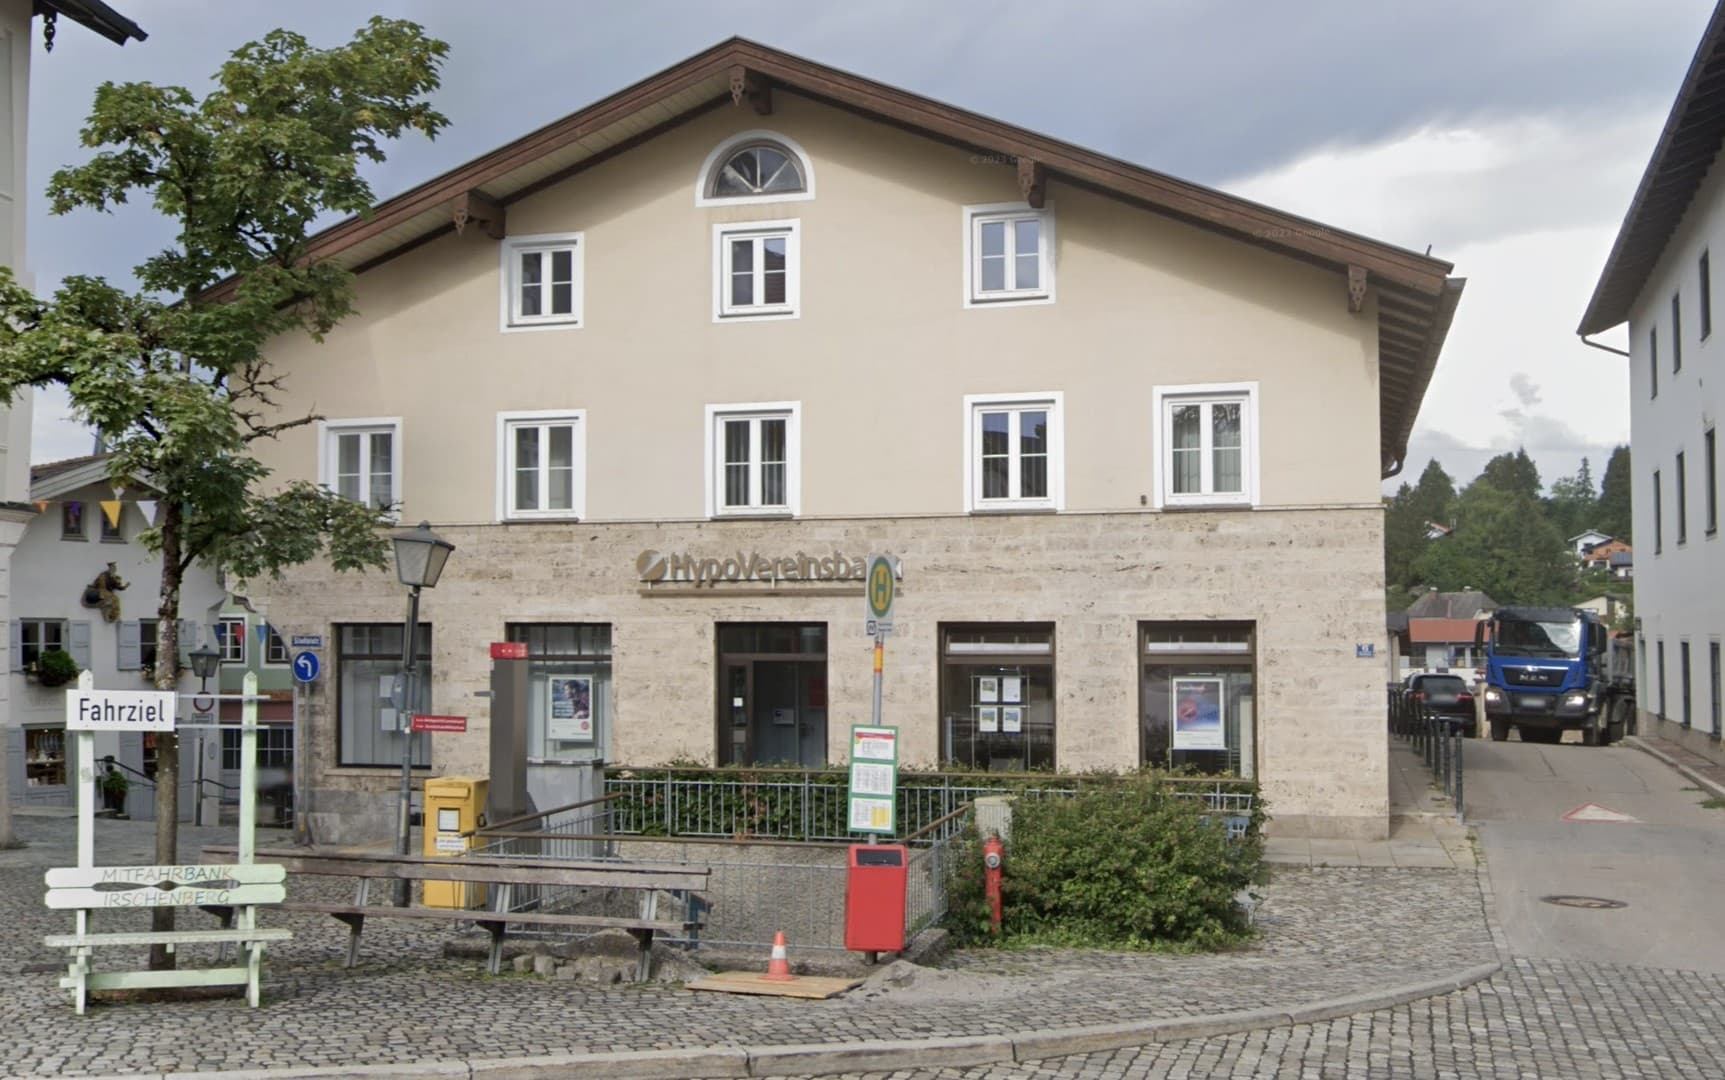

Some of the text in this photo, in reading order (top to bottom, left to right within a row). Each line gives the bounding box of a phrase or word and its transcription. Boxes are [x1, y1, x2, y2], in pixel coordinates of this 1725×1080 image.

[670, 551, 902, 588] HypoVereinsba
[79, 698, 165, 722] Fahrziel
[102, 867, 233, 882] MITFAHRBANK
[104, 890, 230, 906] IRSCHENBERG
